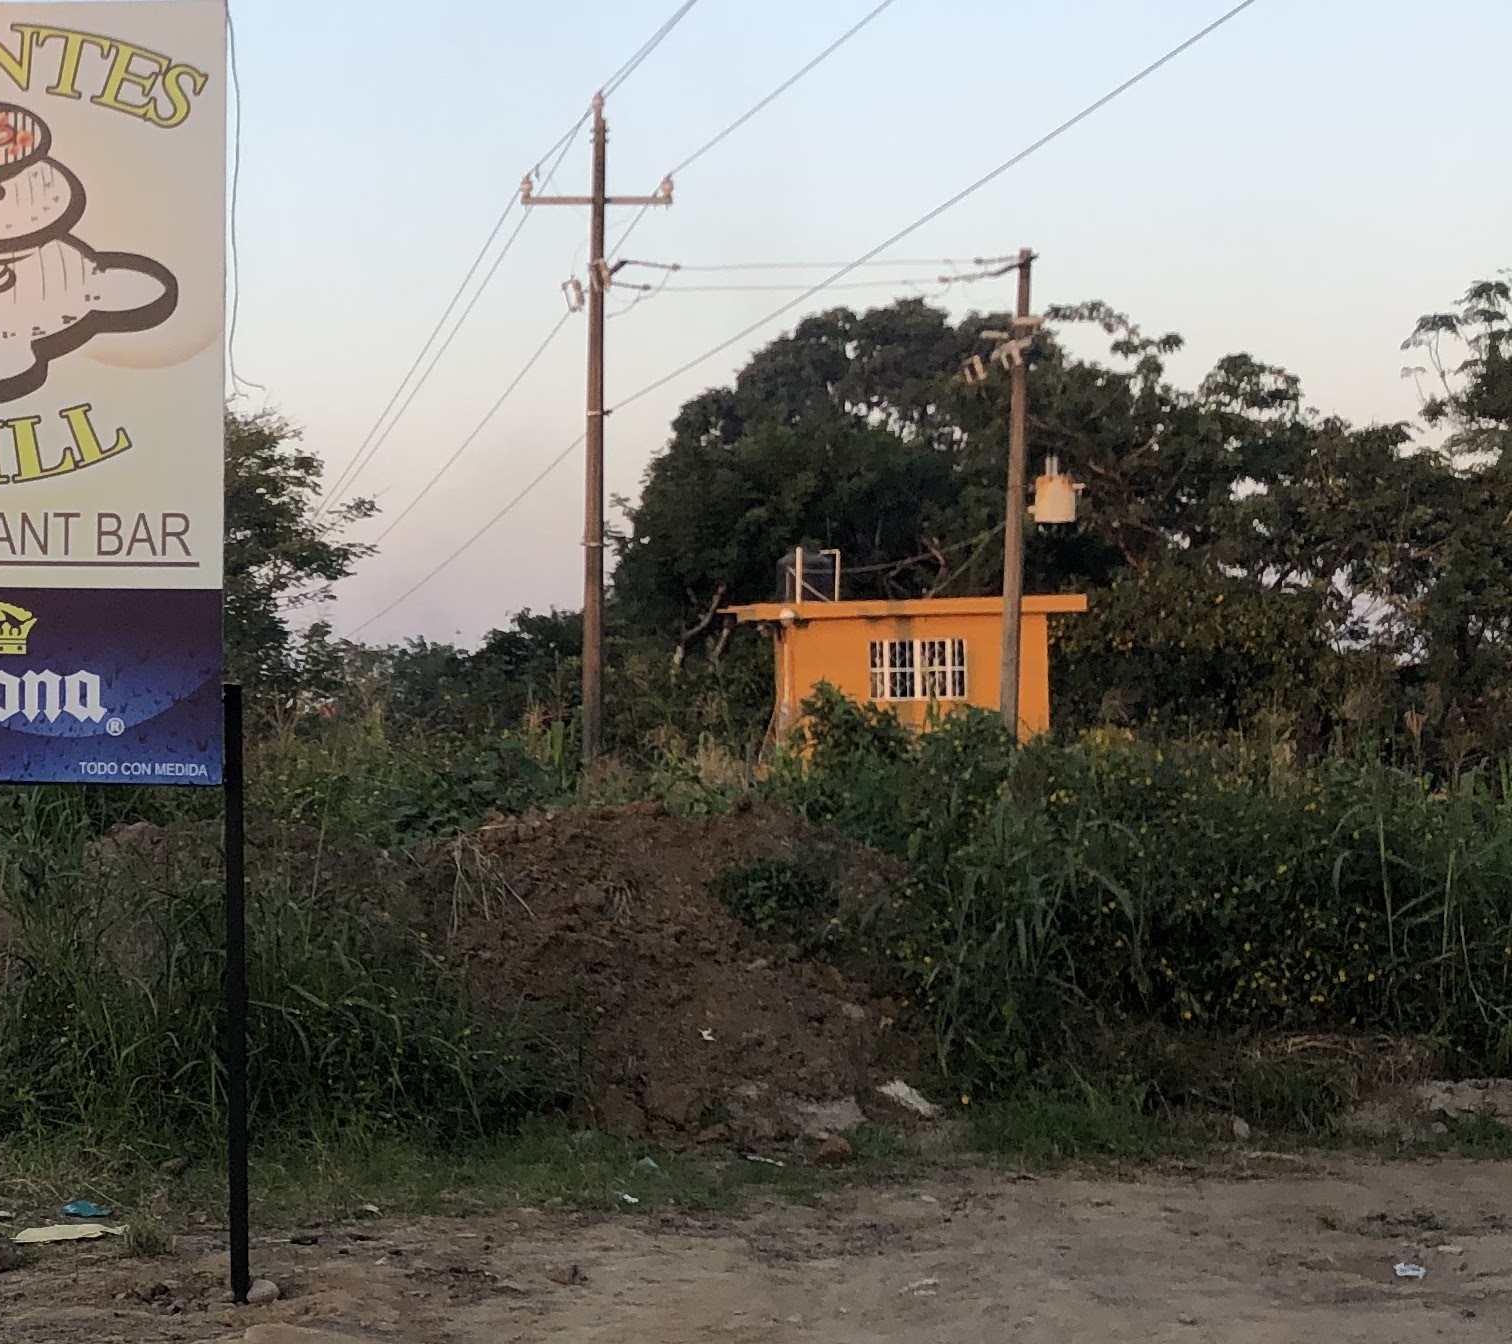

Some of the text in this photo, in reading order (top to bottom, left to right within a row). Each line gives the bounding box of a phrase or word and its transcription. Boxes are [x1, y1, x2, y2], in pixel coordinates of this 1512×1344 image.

[96, 512, 192, 557] BAR
[79, 761, 208, 777] TODO CON MEDIDA
